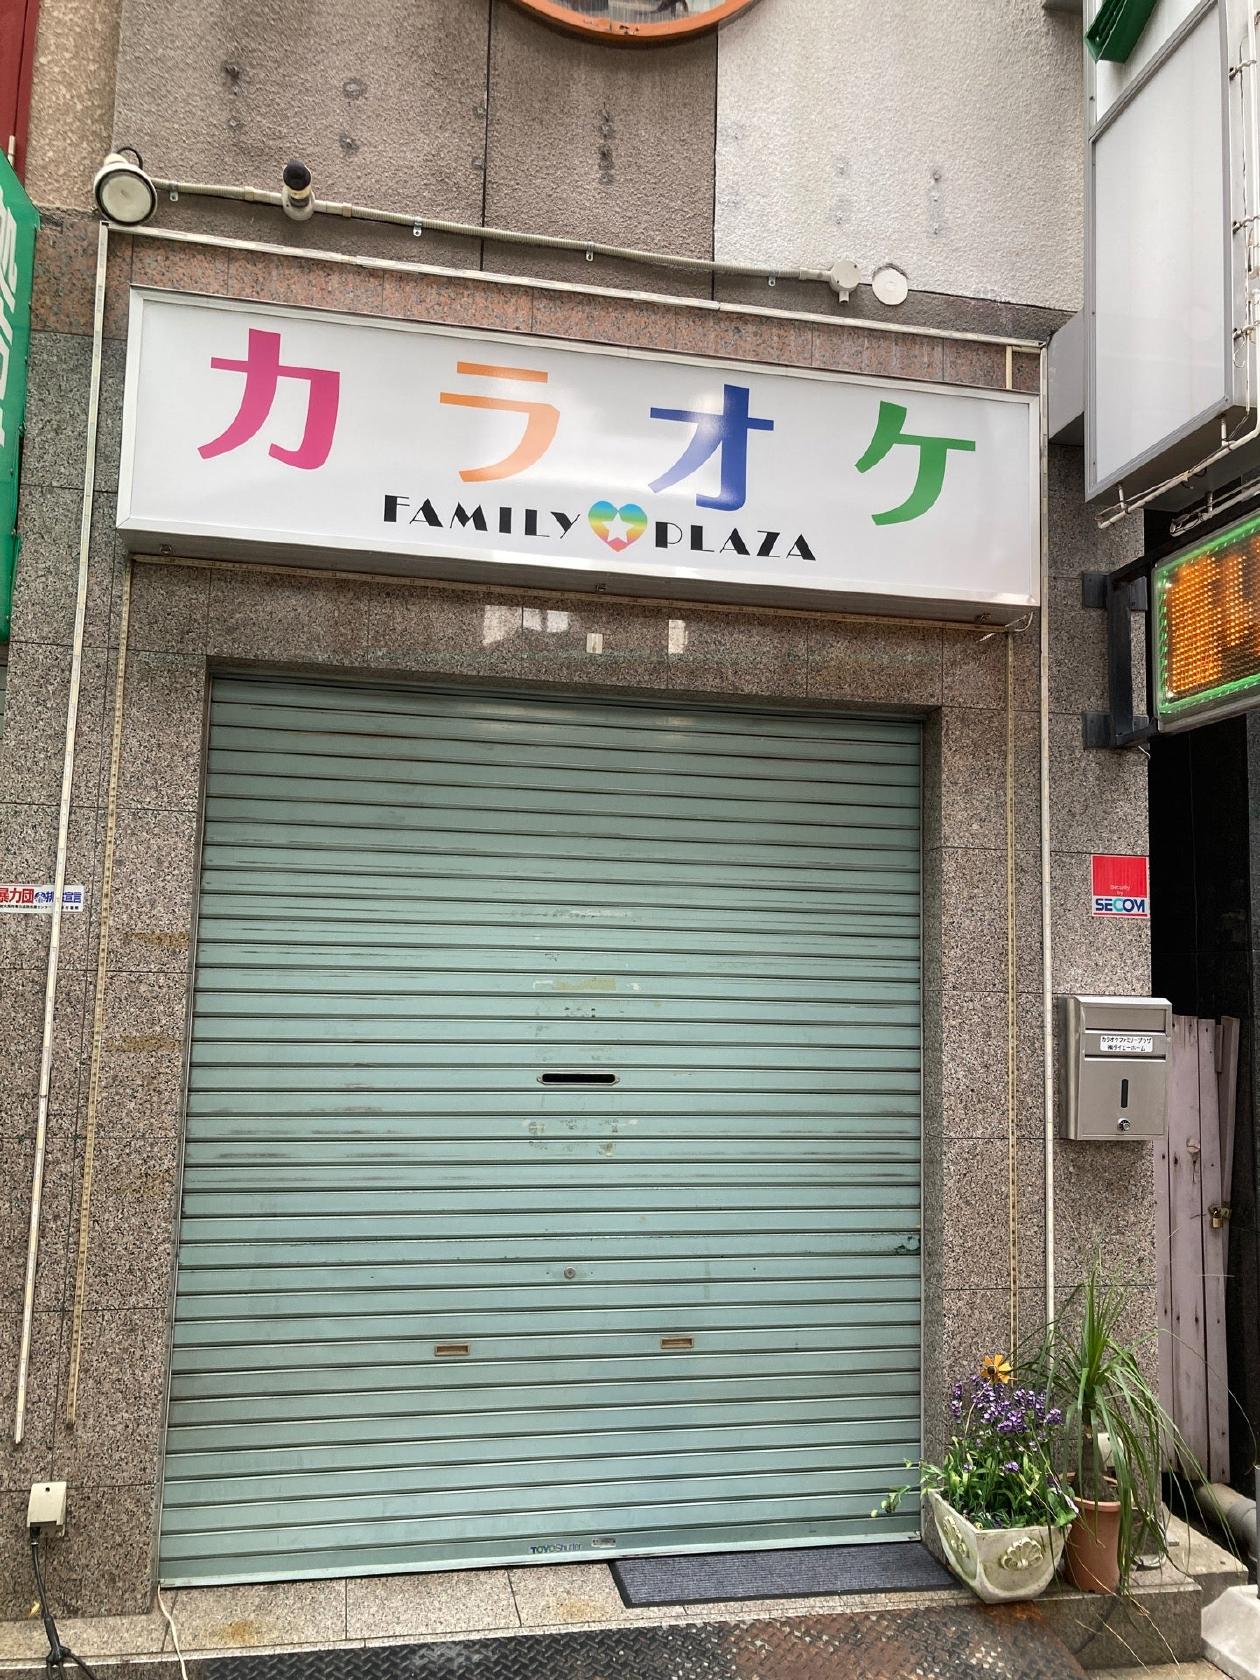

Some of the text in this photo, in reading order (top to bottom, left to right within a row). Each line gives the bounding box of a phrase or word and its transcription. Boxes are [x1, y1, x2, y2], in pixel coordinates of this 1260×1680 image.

[198, 328, 976, 526] カラオケ
[384, 494, 818, 561] FAMILY PLAZA
[1095, 898, 1145, 913] SECOM
